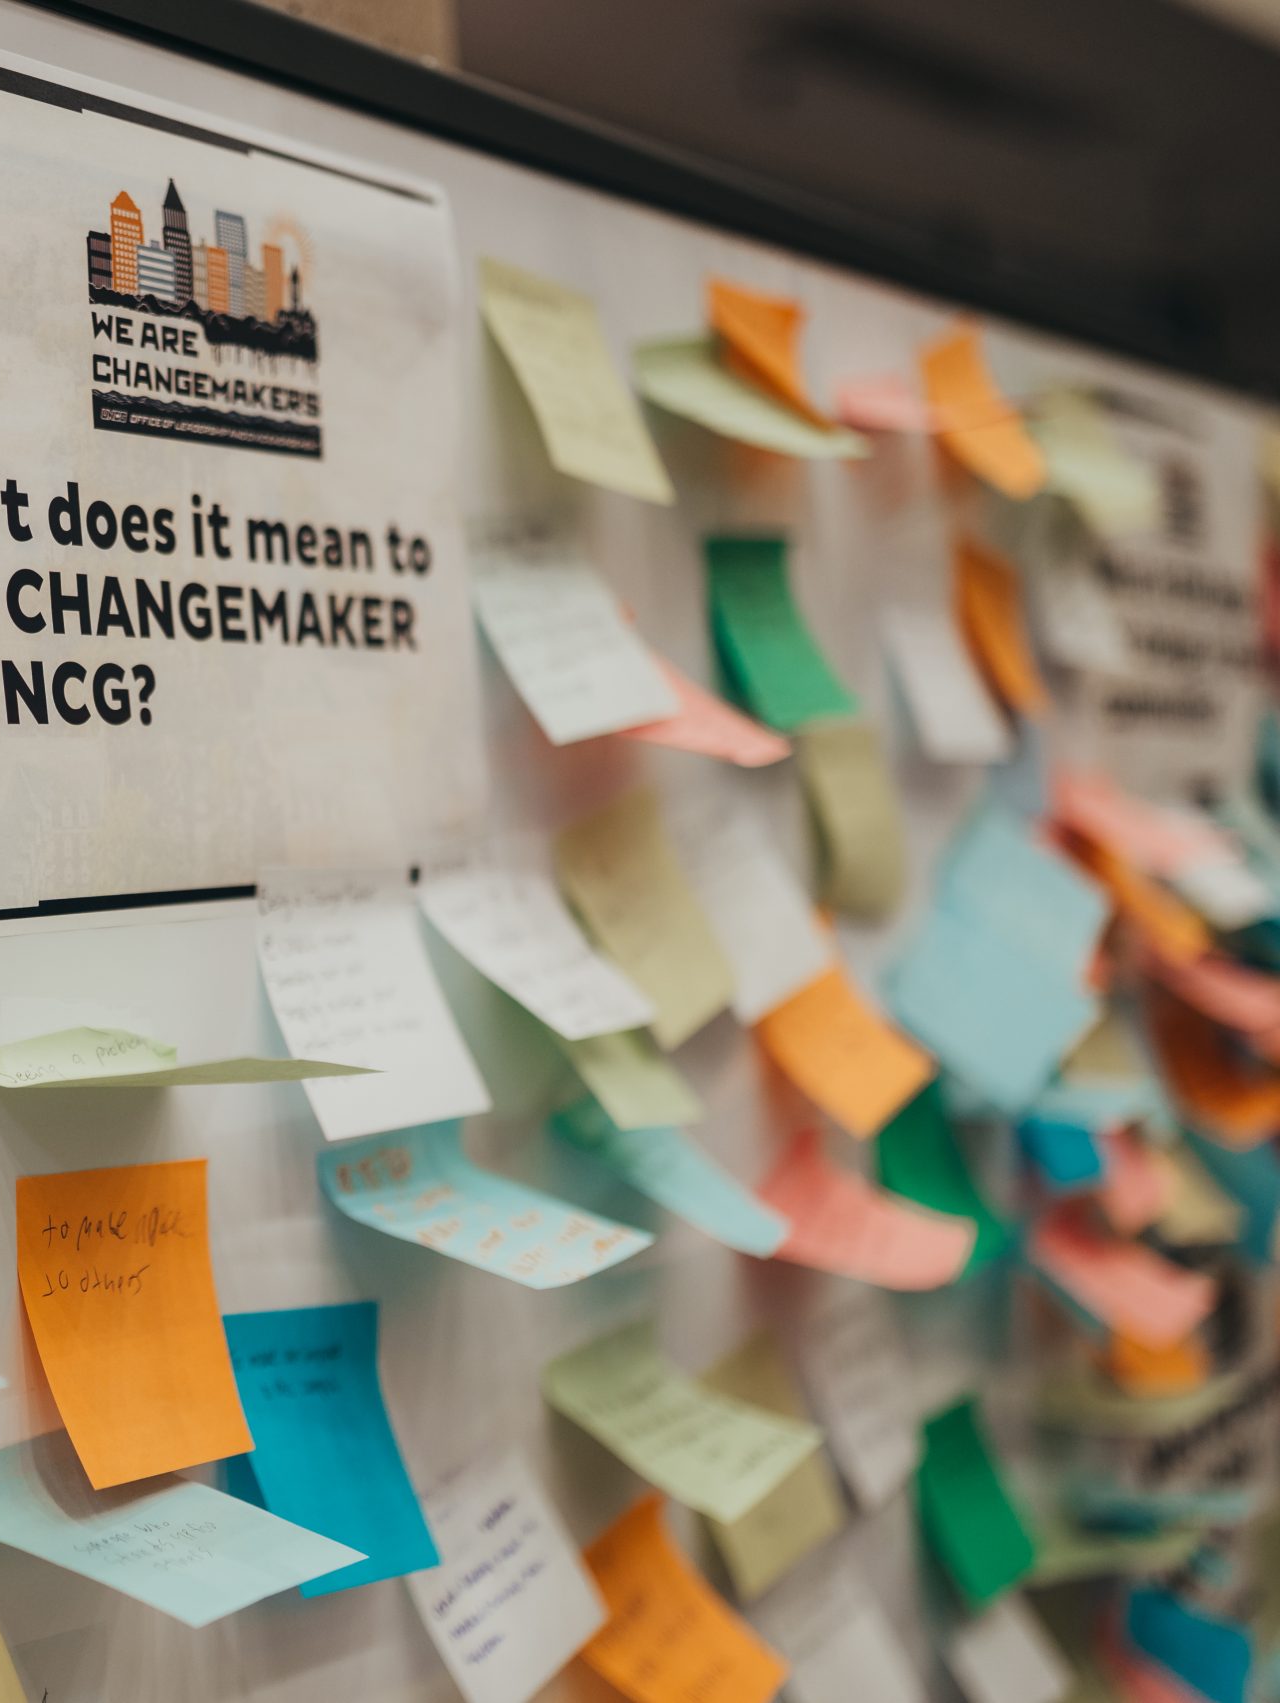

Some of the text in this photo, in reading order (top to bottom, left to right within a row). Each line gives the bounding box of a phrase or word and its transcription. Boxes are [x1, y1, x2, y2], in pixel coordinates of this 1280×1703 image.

[91, 311, 199, 358] WE ARE
[92, 353, 320, 417] CHANGEMAKERS
[130, 414, 161, 428] OFFICE
[49, 481, 177, 555] does
[192, 494, 232, 560] it
[246, 518, 373, 570] mean
[387, 526, 431, 577] to
[6, 568, 418, 652] CHANGEMAKER
[71, 1053, 85, 1066] a
